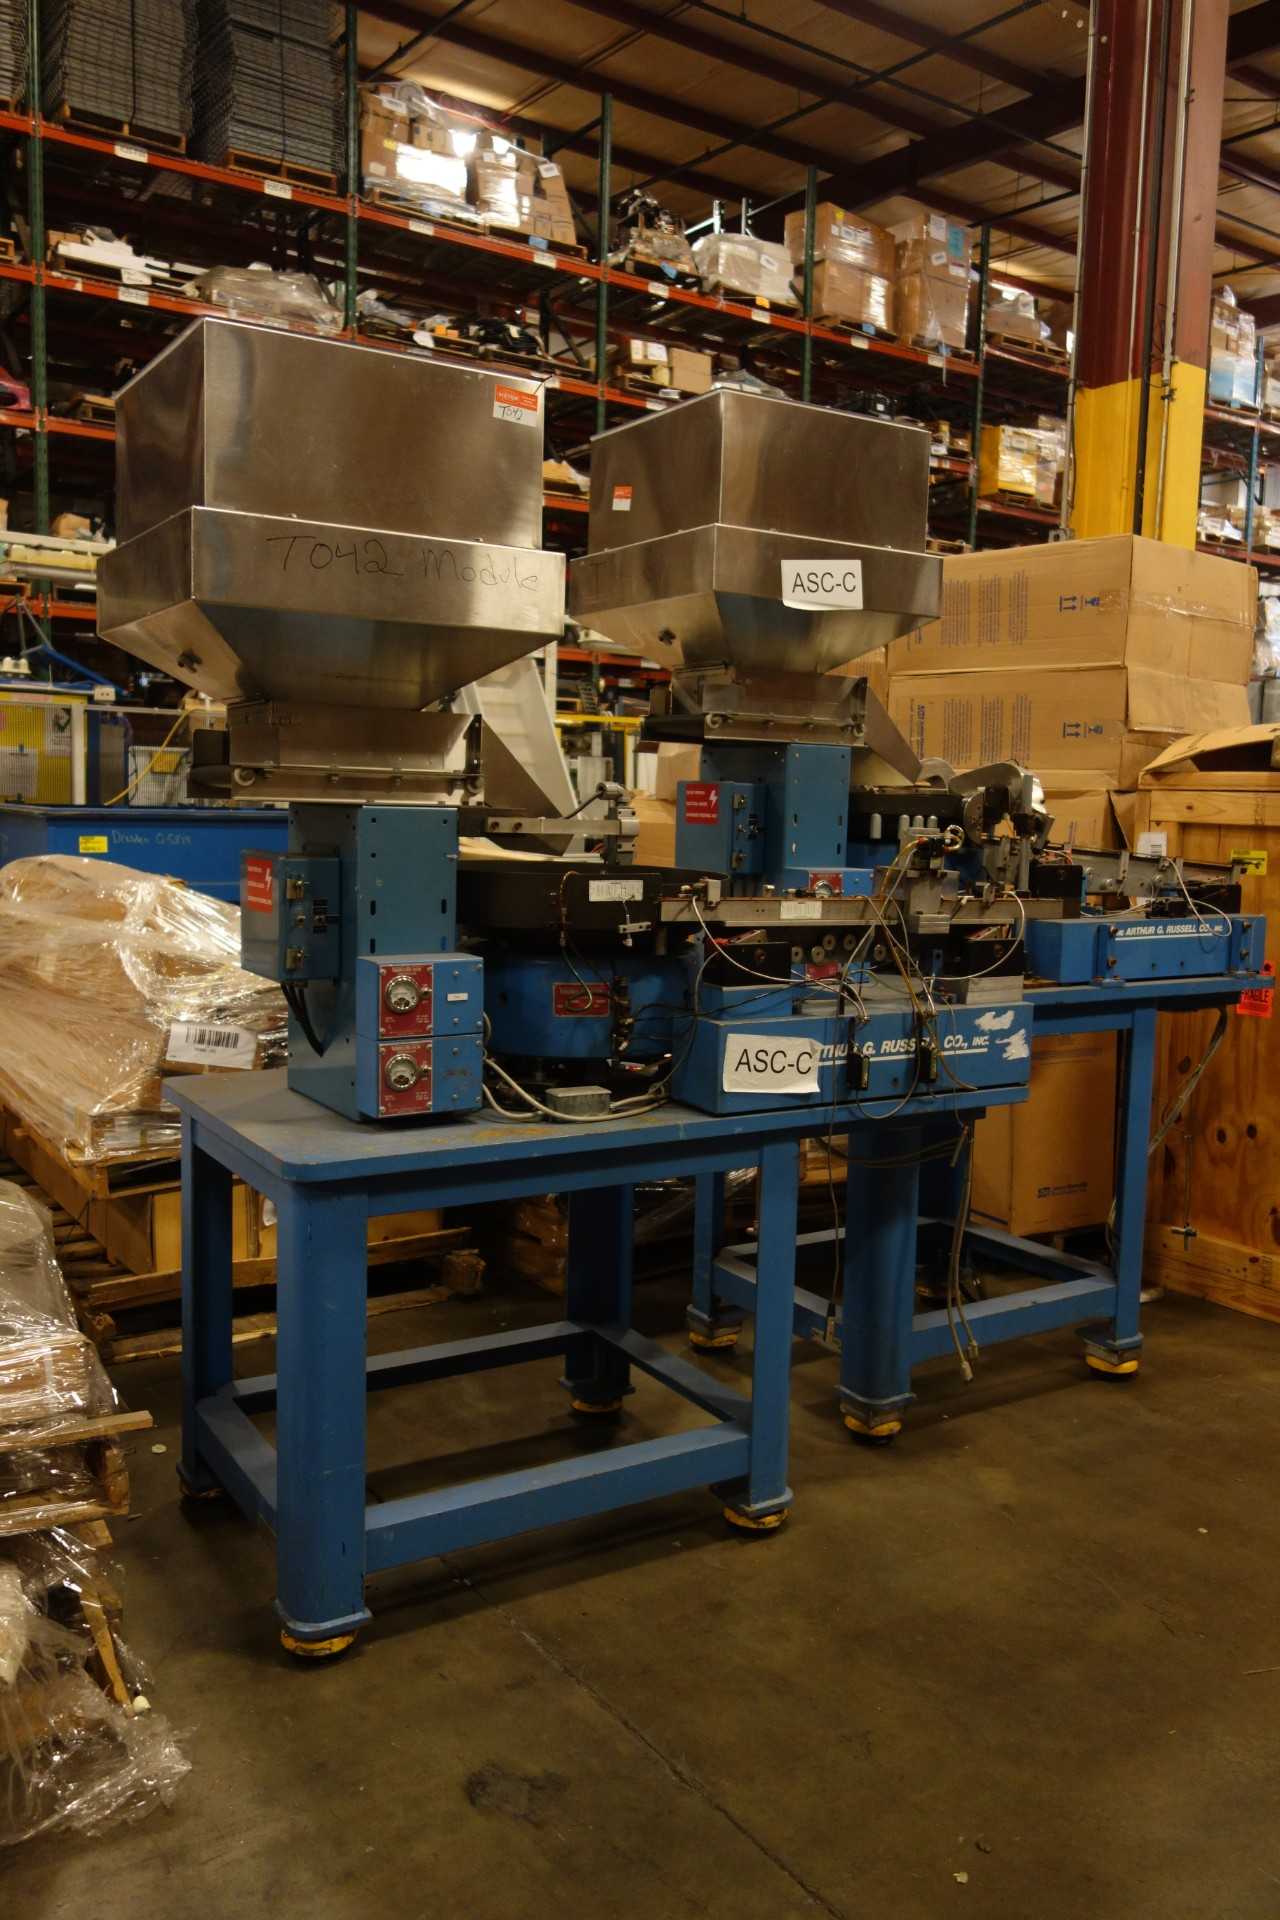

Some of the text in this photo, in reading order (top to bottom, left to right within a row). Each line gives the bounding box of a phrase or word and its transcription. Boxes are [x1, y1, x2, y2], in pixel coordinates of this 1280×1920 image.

[266, 536, 538, 592] T042 Module
[792, 572, 856, 593] ASC-C
[1125, 926, 1155, 937] ARTHUR
[1166, 924, 1197, 935] RUSSELL
[943, 1034, 968, 1050] CO.,
[734, 1048, 813, 1075] ASC-C
